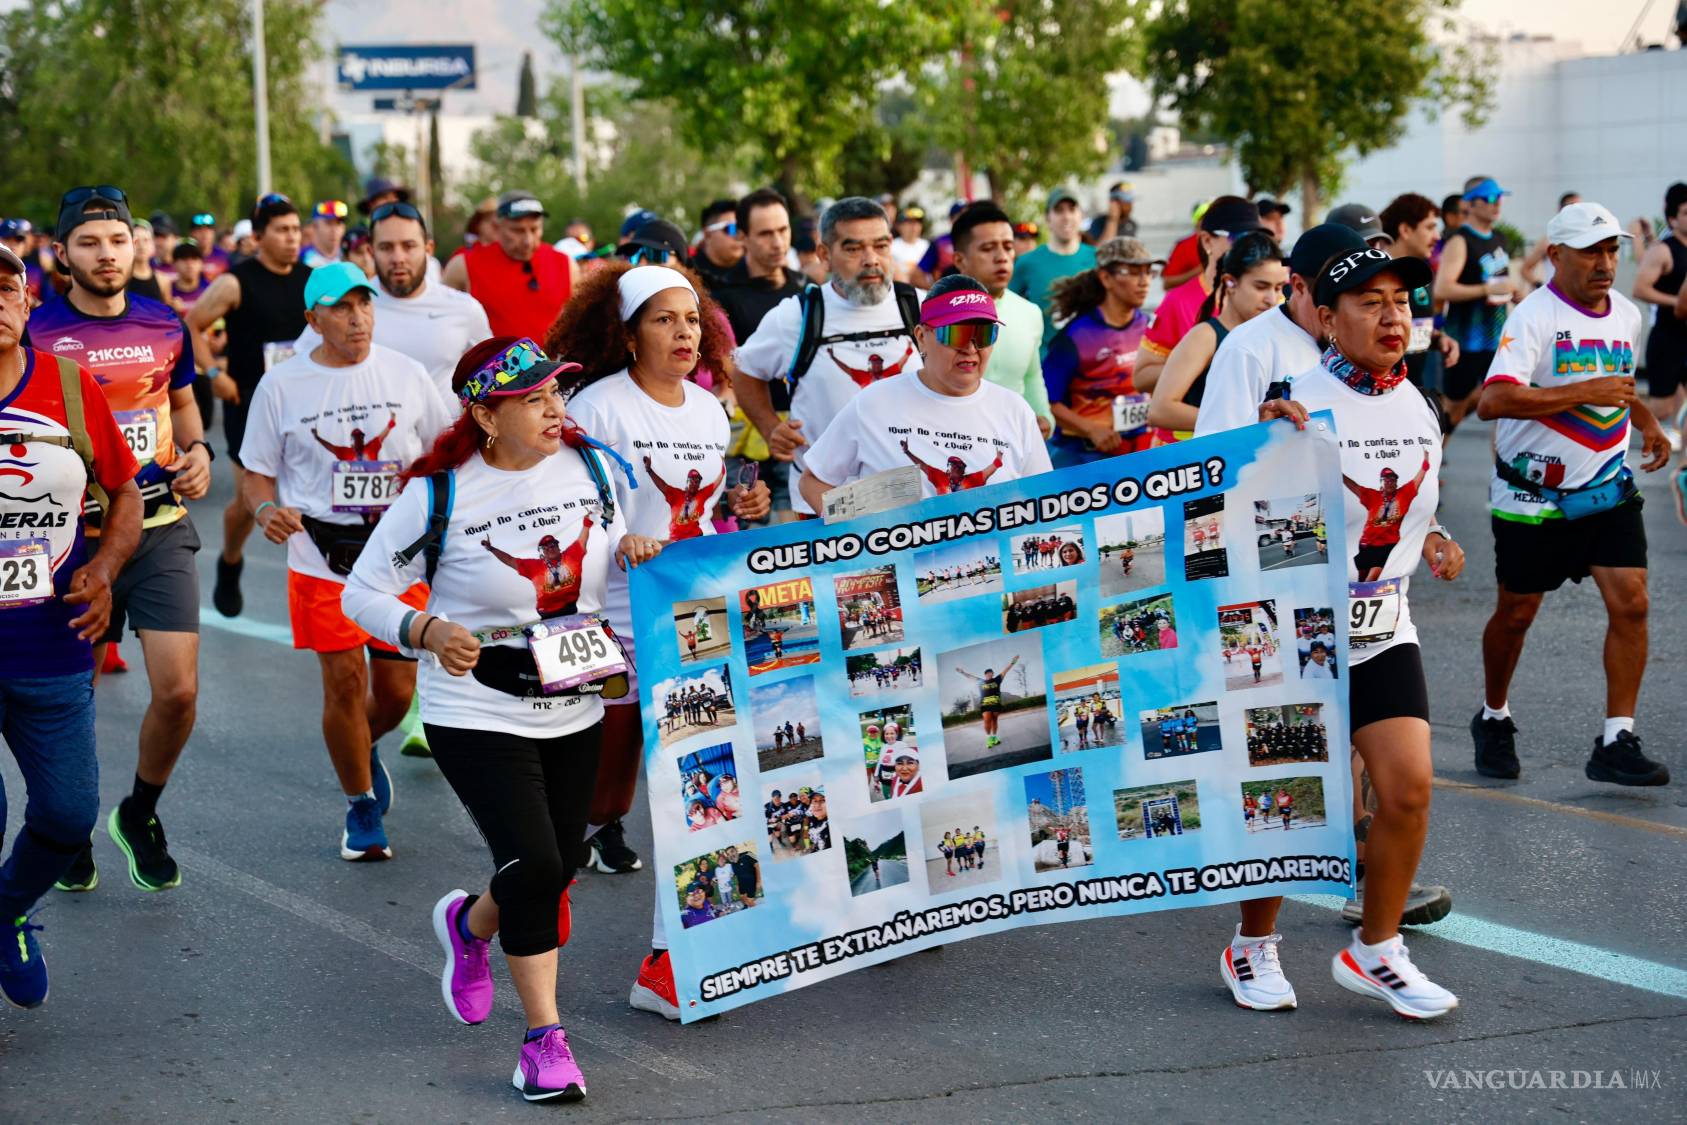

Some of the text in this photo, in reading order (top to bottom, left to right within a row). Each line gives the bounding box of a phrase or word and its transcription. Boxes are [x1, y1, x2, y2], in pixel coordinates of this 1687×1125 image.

[1329, 249, 1393, 283] SPO
[1557, 331, 1571, 340] DE
[87, 346, 154, 362] 21KCOAH
[917, 428, 930, 436] No
[935, 431, 972, 441] confias
[977, 436, 988, 444] en
[1348, 440, 1360, 448] No
[1364, 438, 1398, 447] confias
[343, 475, 393, 499] 5787
[496, 515, 512, 525] No
[518, 505, 558, 518] confias
[563, 501, 576, 510] en
[580, 498, 599, 506] Dios
[748, 458, 1225, 573] QUE NO CONFIAS EN DIOS O QUE ?
[0, 559, 38, 591] 23
[760, 580, 812, 606] META
[559, 630, 607, 666] 495
[701, 856, 1352, 1001] SIEMPRE TE EXTRAÑAREMOS, PERO NUNCA TE OLVIDAREMOS
